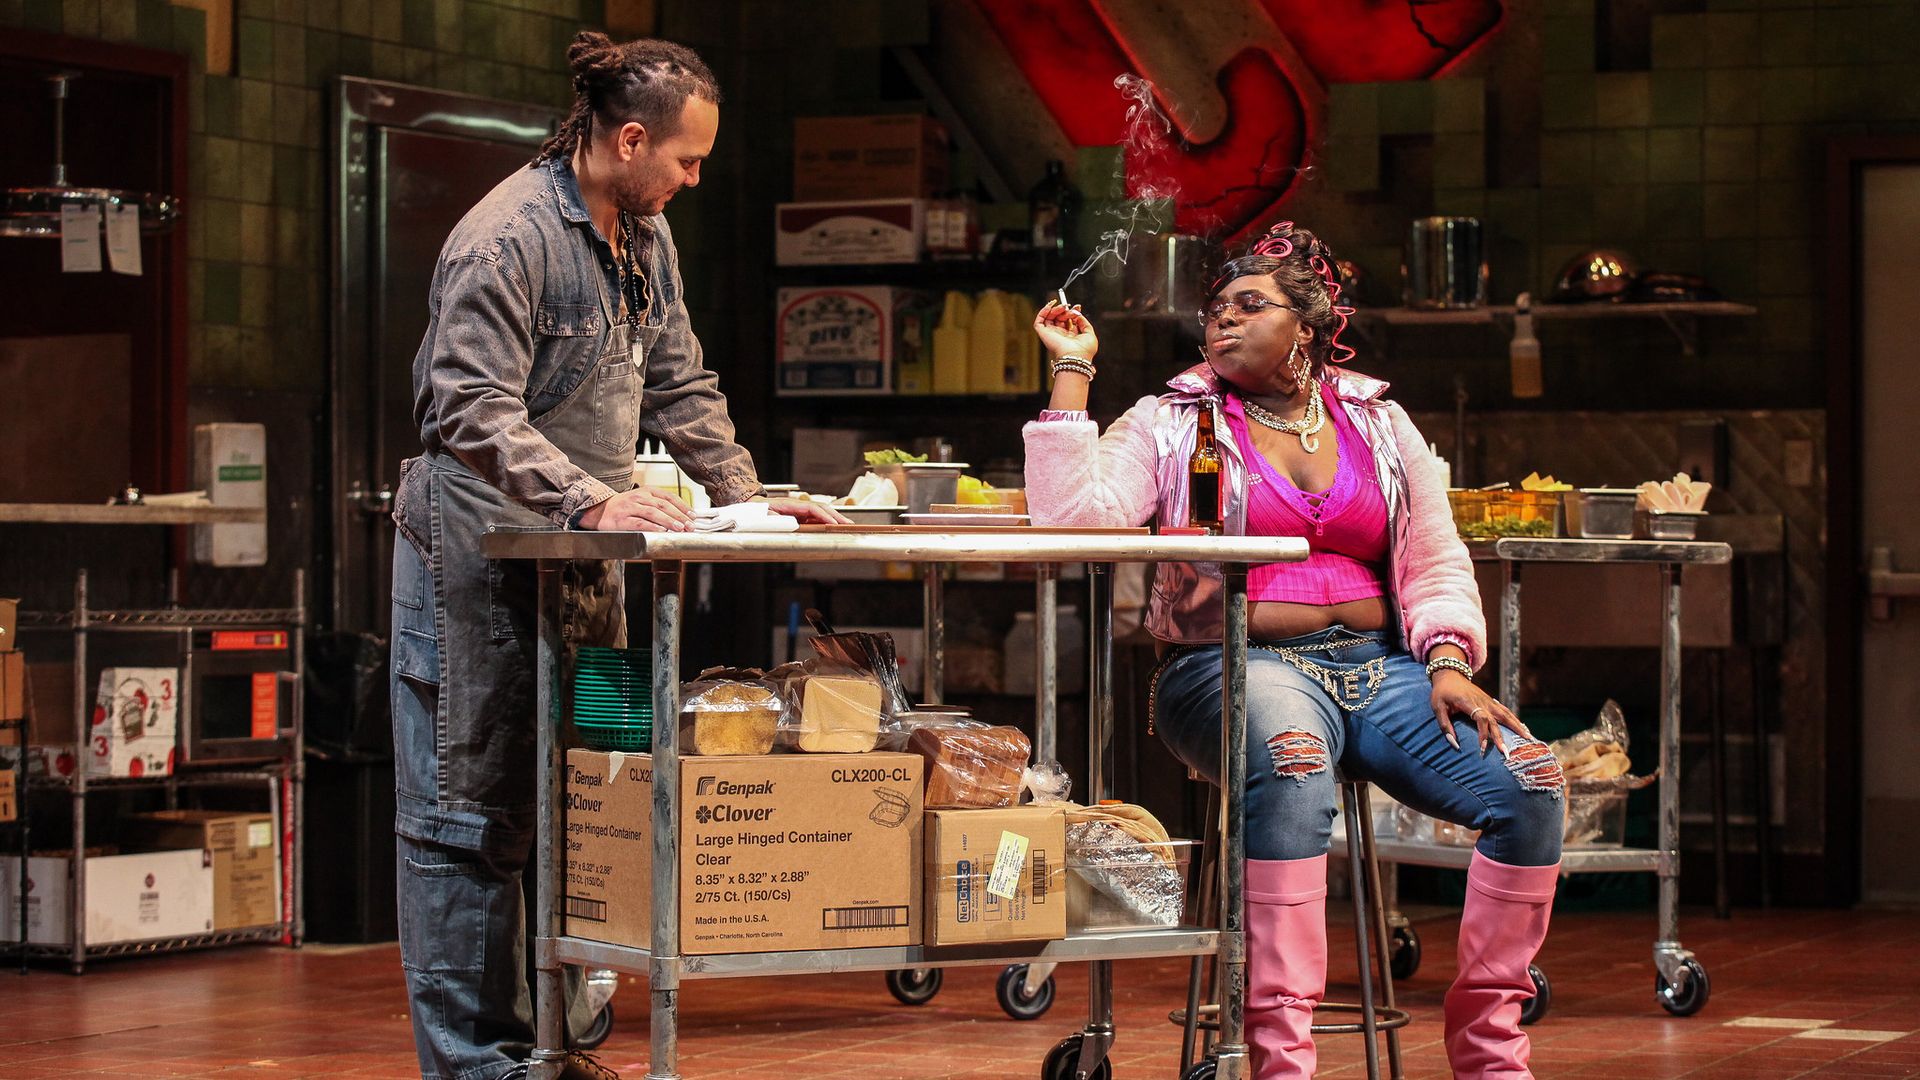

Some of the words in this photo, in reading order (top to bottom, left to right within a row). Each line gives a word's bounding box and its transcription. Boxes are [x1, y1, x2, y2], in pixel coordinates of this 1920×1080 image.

[161, 679, 172, 701] 3
[94, 736, 109, 757] 3
[575, 770, 603, 789] Genpak
[629, 767, 653, 783] CLX20
[831, 768, 911, 783] CLX200-CL
[716, 780, 774, 798] Genpak
[573, 793, 603, 812] Clover
[712, 804, 774, 822] Clover
[585, 821, 608, 838] Hinged
[609, 824, 642, 841] Container
[696, 834, 733, 848] Large
[738, 832, 784, 847] Hinged
[788, 831, 852, 843] Container
[696, 853, 731, 866] Clear
[695, 873, 725, 885] 8.35”
[728, 875, 735, 884] x
[738, 872, 767, 884] 8.32”
[771, 874, 777, 883] x
[780, 871, 810, 882] 2.88”
[695, 891, 721, 903] 2/75
[723, 891, 740, 902] Ct.
[744, 889, 791, 903] (150/Cs)
[695, 916, 717, 925] Made
[719, 915, 727, 924] in
[729, 915, 743, 924] the
[744, 914, 770, 923] U.S.A.
